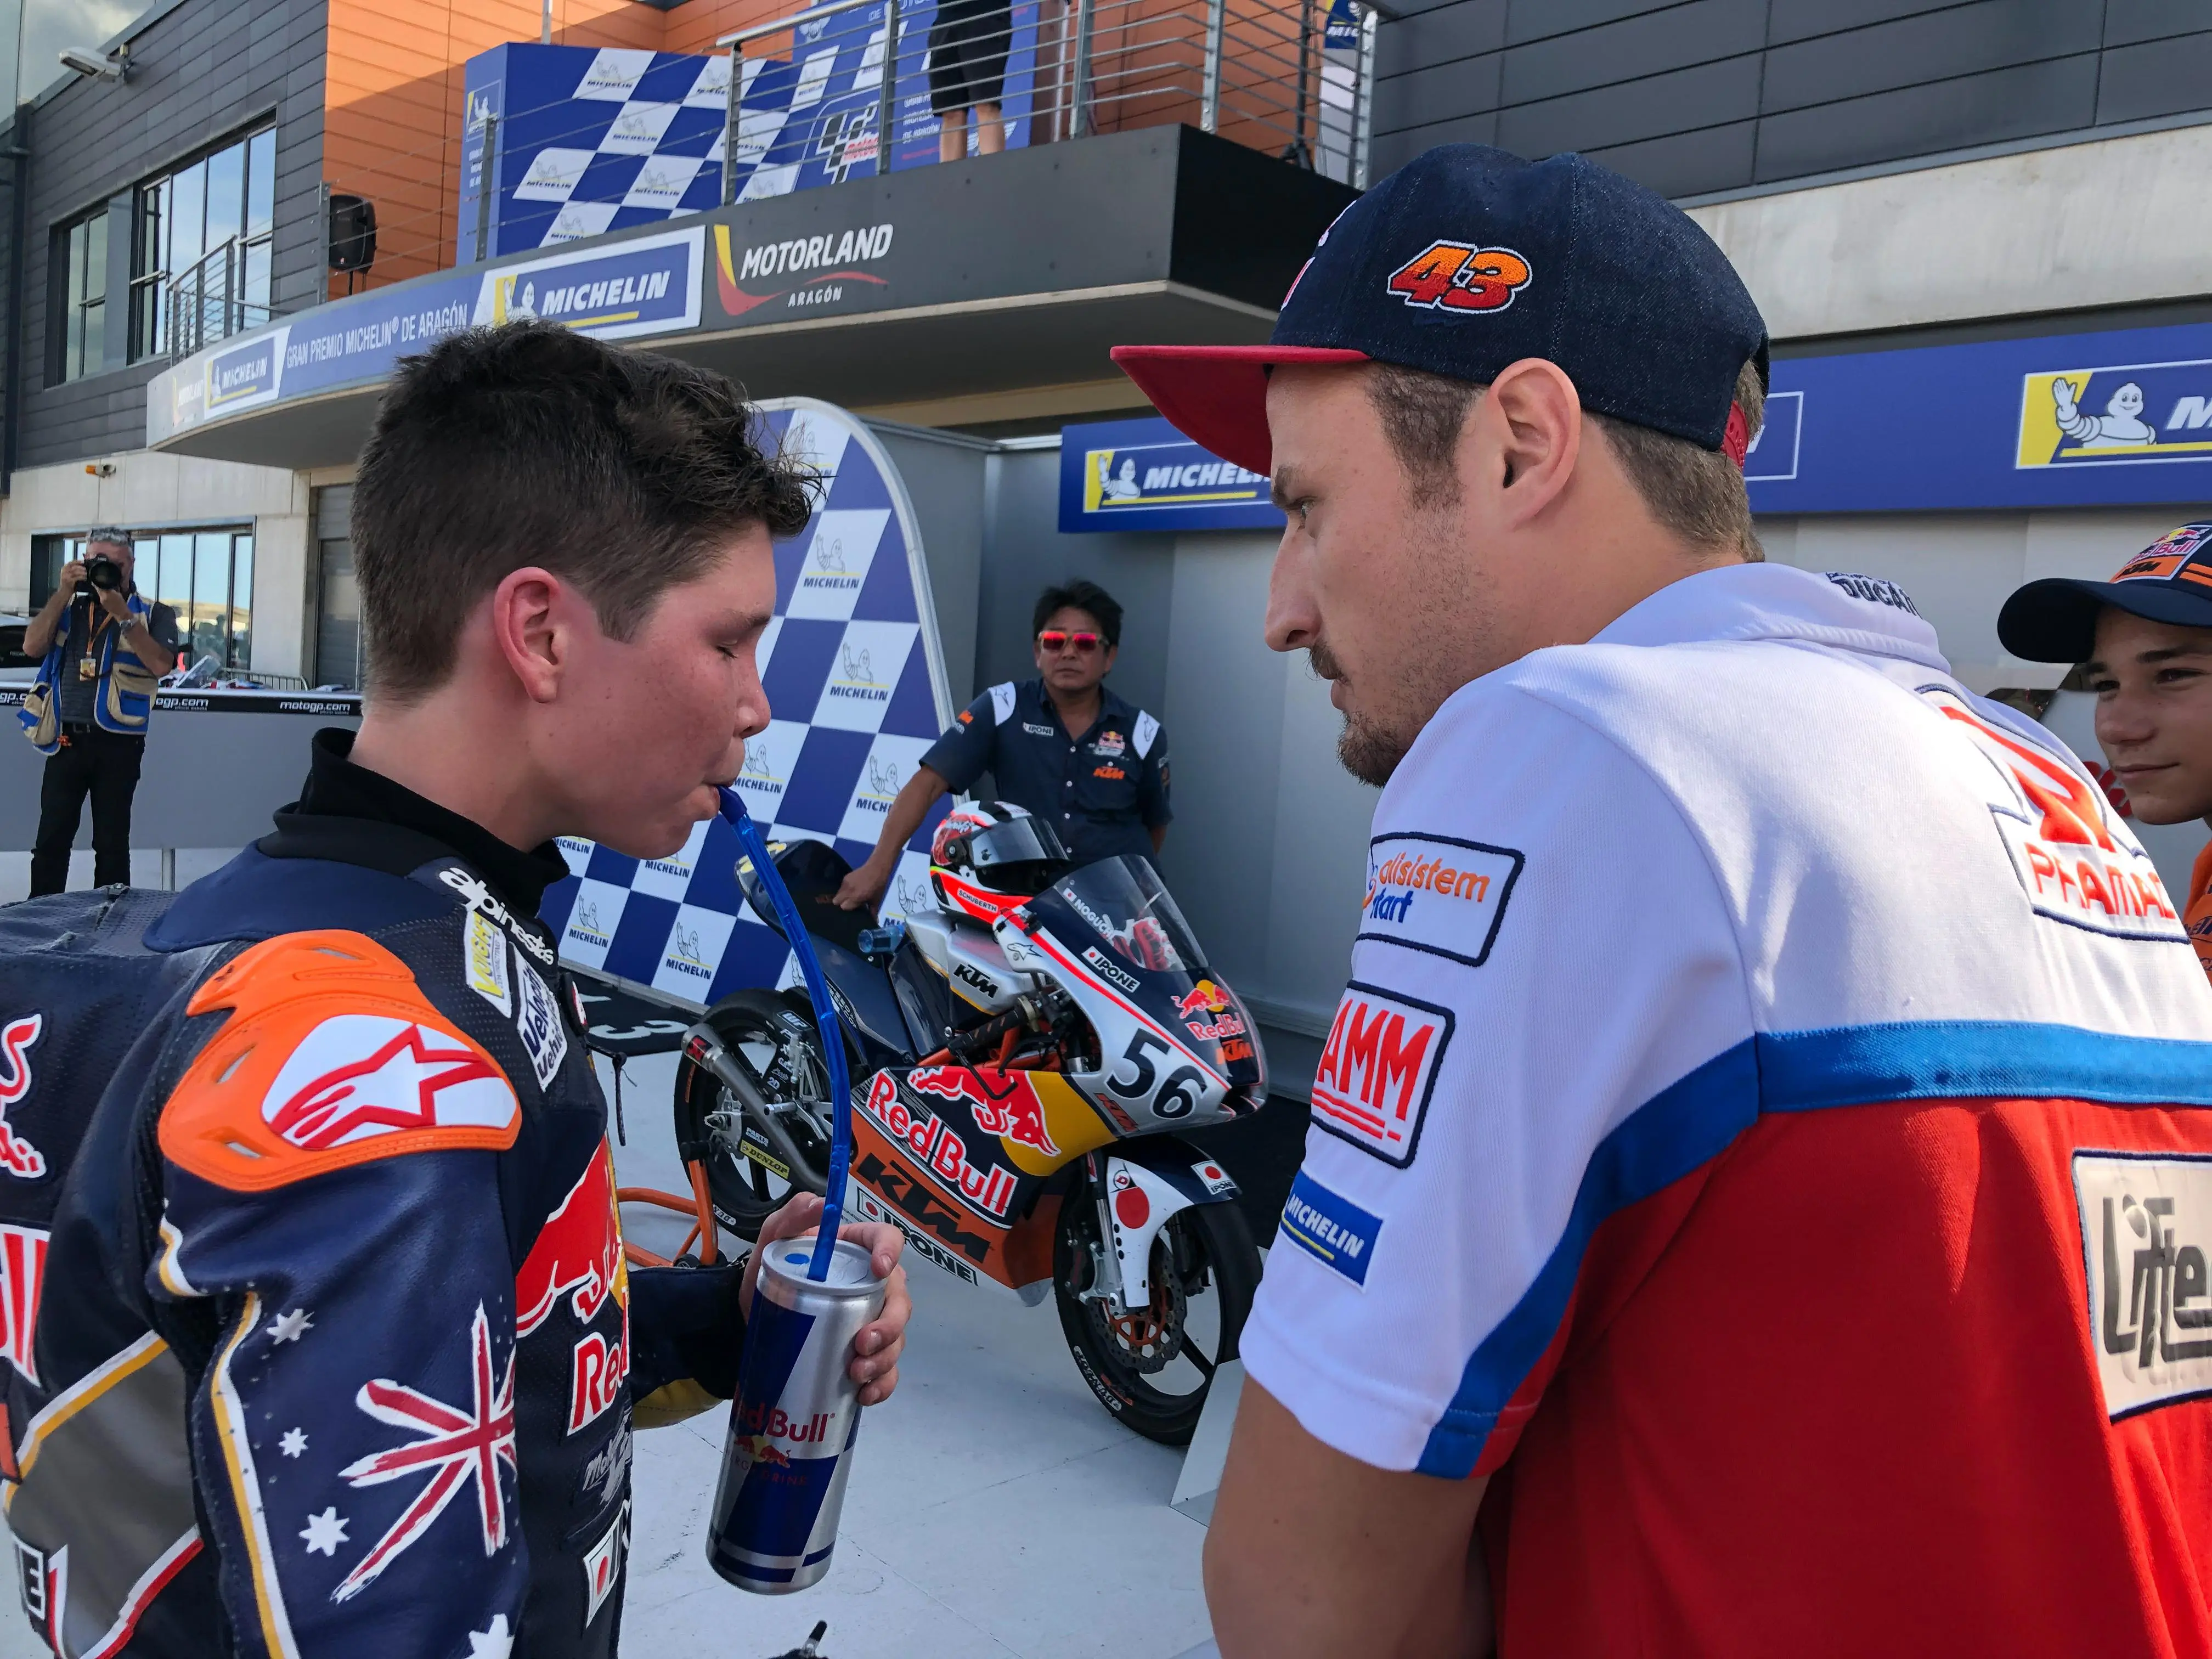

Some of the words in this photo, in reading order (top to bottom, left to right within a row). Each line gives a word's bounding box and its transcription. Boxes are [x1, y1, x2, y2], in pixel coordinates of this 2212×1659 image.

[527, 180, 572, 189] MICHELIN
[635, 187, 680, 196] MICHELIN
[740, 224, 894, 280] MOTORLAND
[1389, 240, 1532, 313] 43
[541, 270, 671, 317] MICHELIN
[788, 284, 843, 307] ARAGÓN
[287, 340, 309, 369] GRAN
[310, 333, 343, 363] PREMIO
[401, 314, 416, 343] DE
[417, 300, 468, 339] ARAGÓN
[222, 356, 268, 391] MICHELIN
[2154, 540, 2197, 555] Bull
[803, 577, 860, 589] MICHELIN
[280, 700, 351, 713] motogp.com
[830, 686, 889, 702] MICHELIN
[732, 777, 783, 794] MICHELIN
[555, 838, 590, 855] MICHELIN
[645, 859, 690, 878] MICHELIN
[958, 889, 997, 912] SCHUBERTH
[569, 928, 609, 948] MICHELIN
[665, 957, 712, 980] MICHELIN
[953, 963, 999, 999] KTM
[1093, 956, 1138, 990] IPONE
[1186, 1014, 1229, 1041] Red
[1105, 1028, 1207, 1119] 56
[868, 1071, 939, 1159] Red
[933, 1129, 1015, 1215] Bull
[748, 1147, 789, 1174] DUNLOP
[1211, 1181, 1235, 1193] IPONE
[856, 1152, 991, 1264] KTM
[1287, 1194, 1364, 1259] MICHELIN
[766, 1408, 829, 1442] Bull
